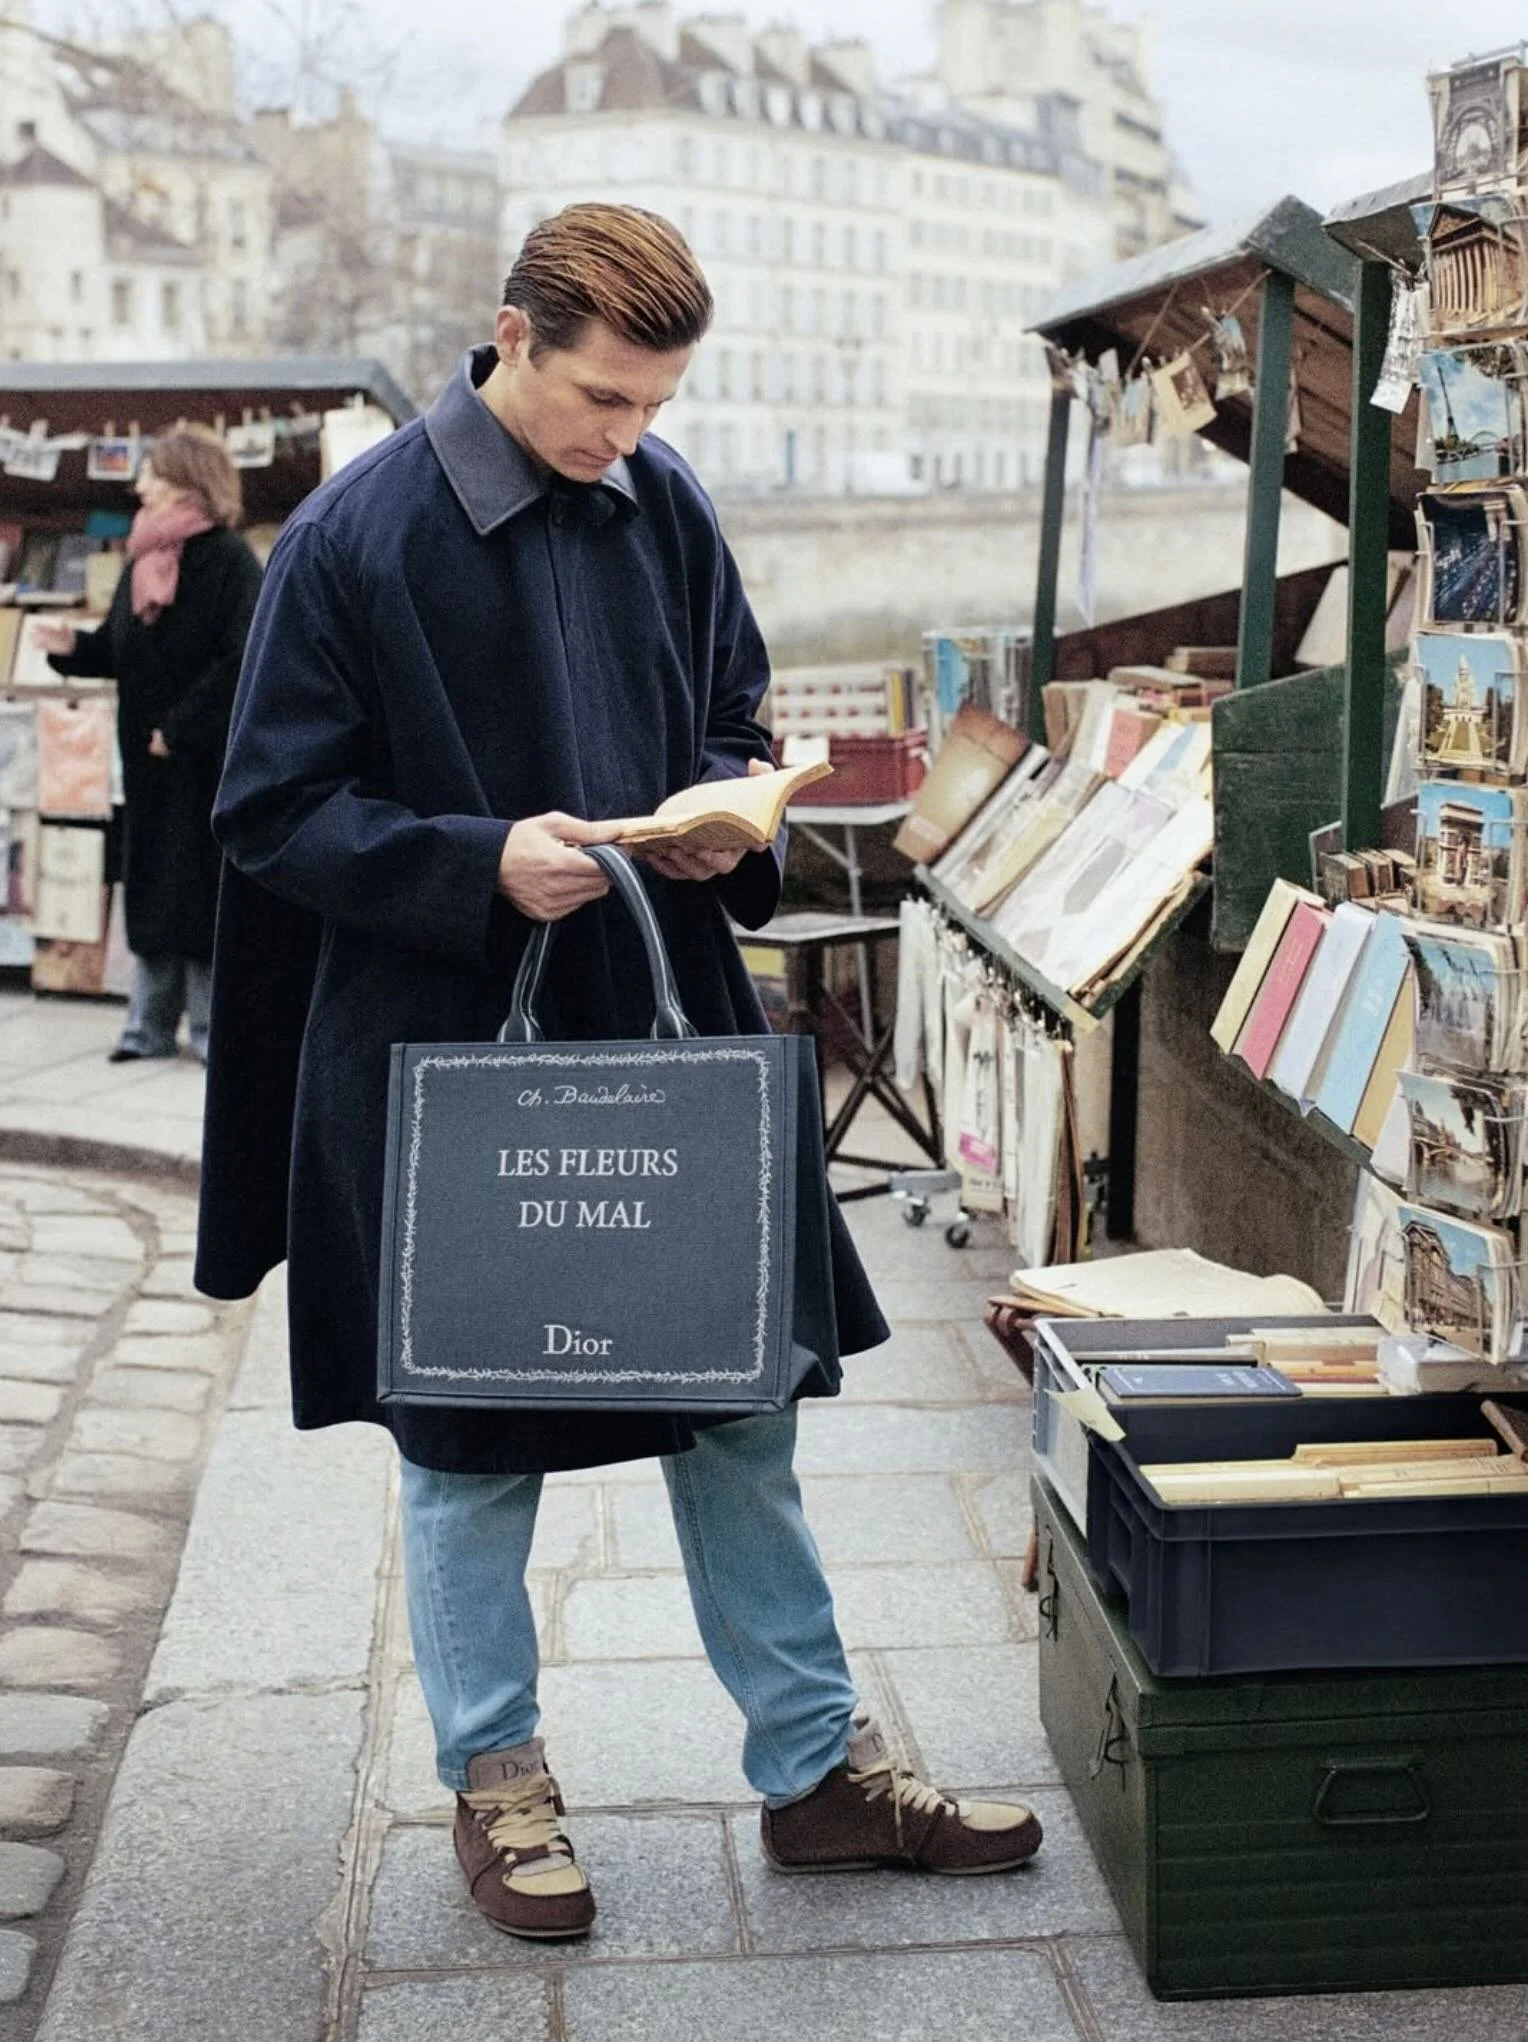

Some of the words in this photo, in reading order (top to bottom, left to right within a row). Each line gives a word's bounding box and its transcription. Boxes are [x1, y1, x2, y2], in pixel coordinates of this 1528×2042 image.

[553, 1083, 666, 1105] Baudelaire
[497, 1148, 550, 1177] LES
[558, 1148, 679, 1177] FLEURS
[518, 1200, 569, 1228] DU
[575, 1200, 652, 1229] MAL
[542, 1324, 613, 1356] Dior
